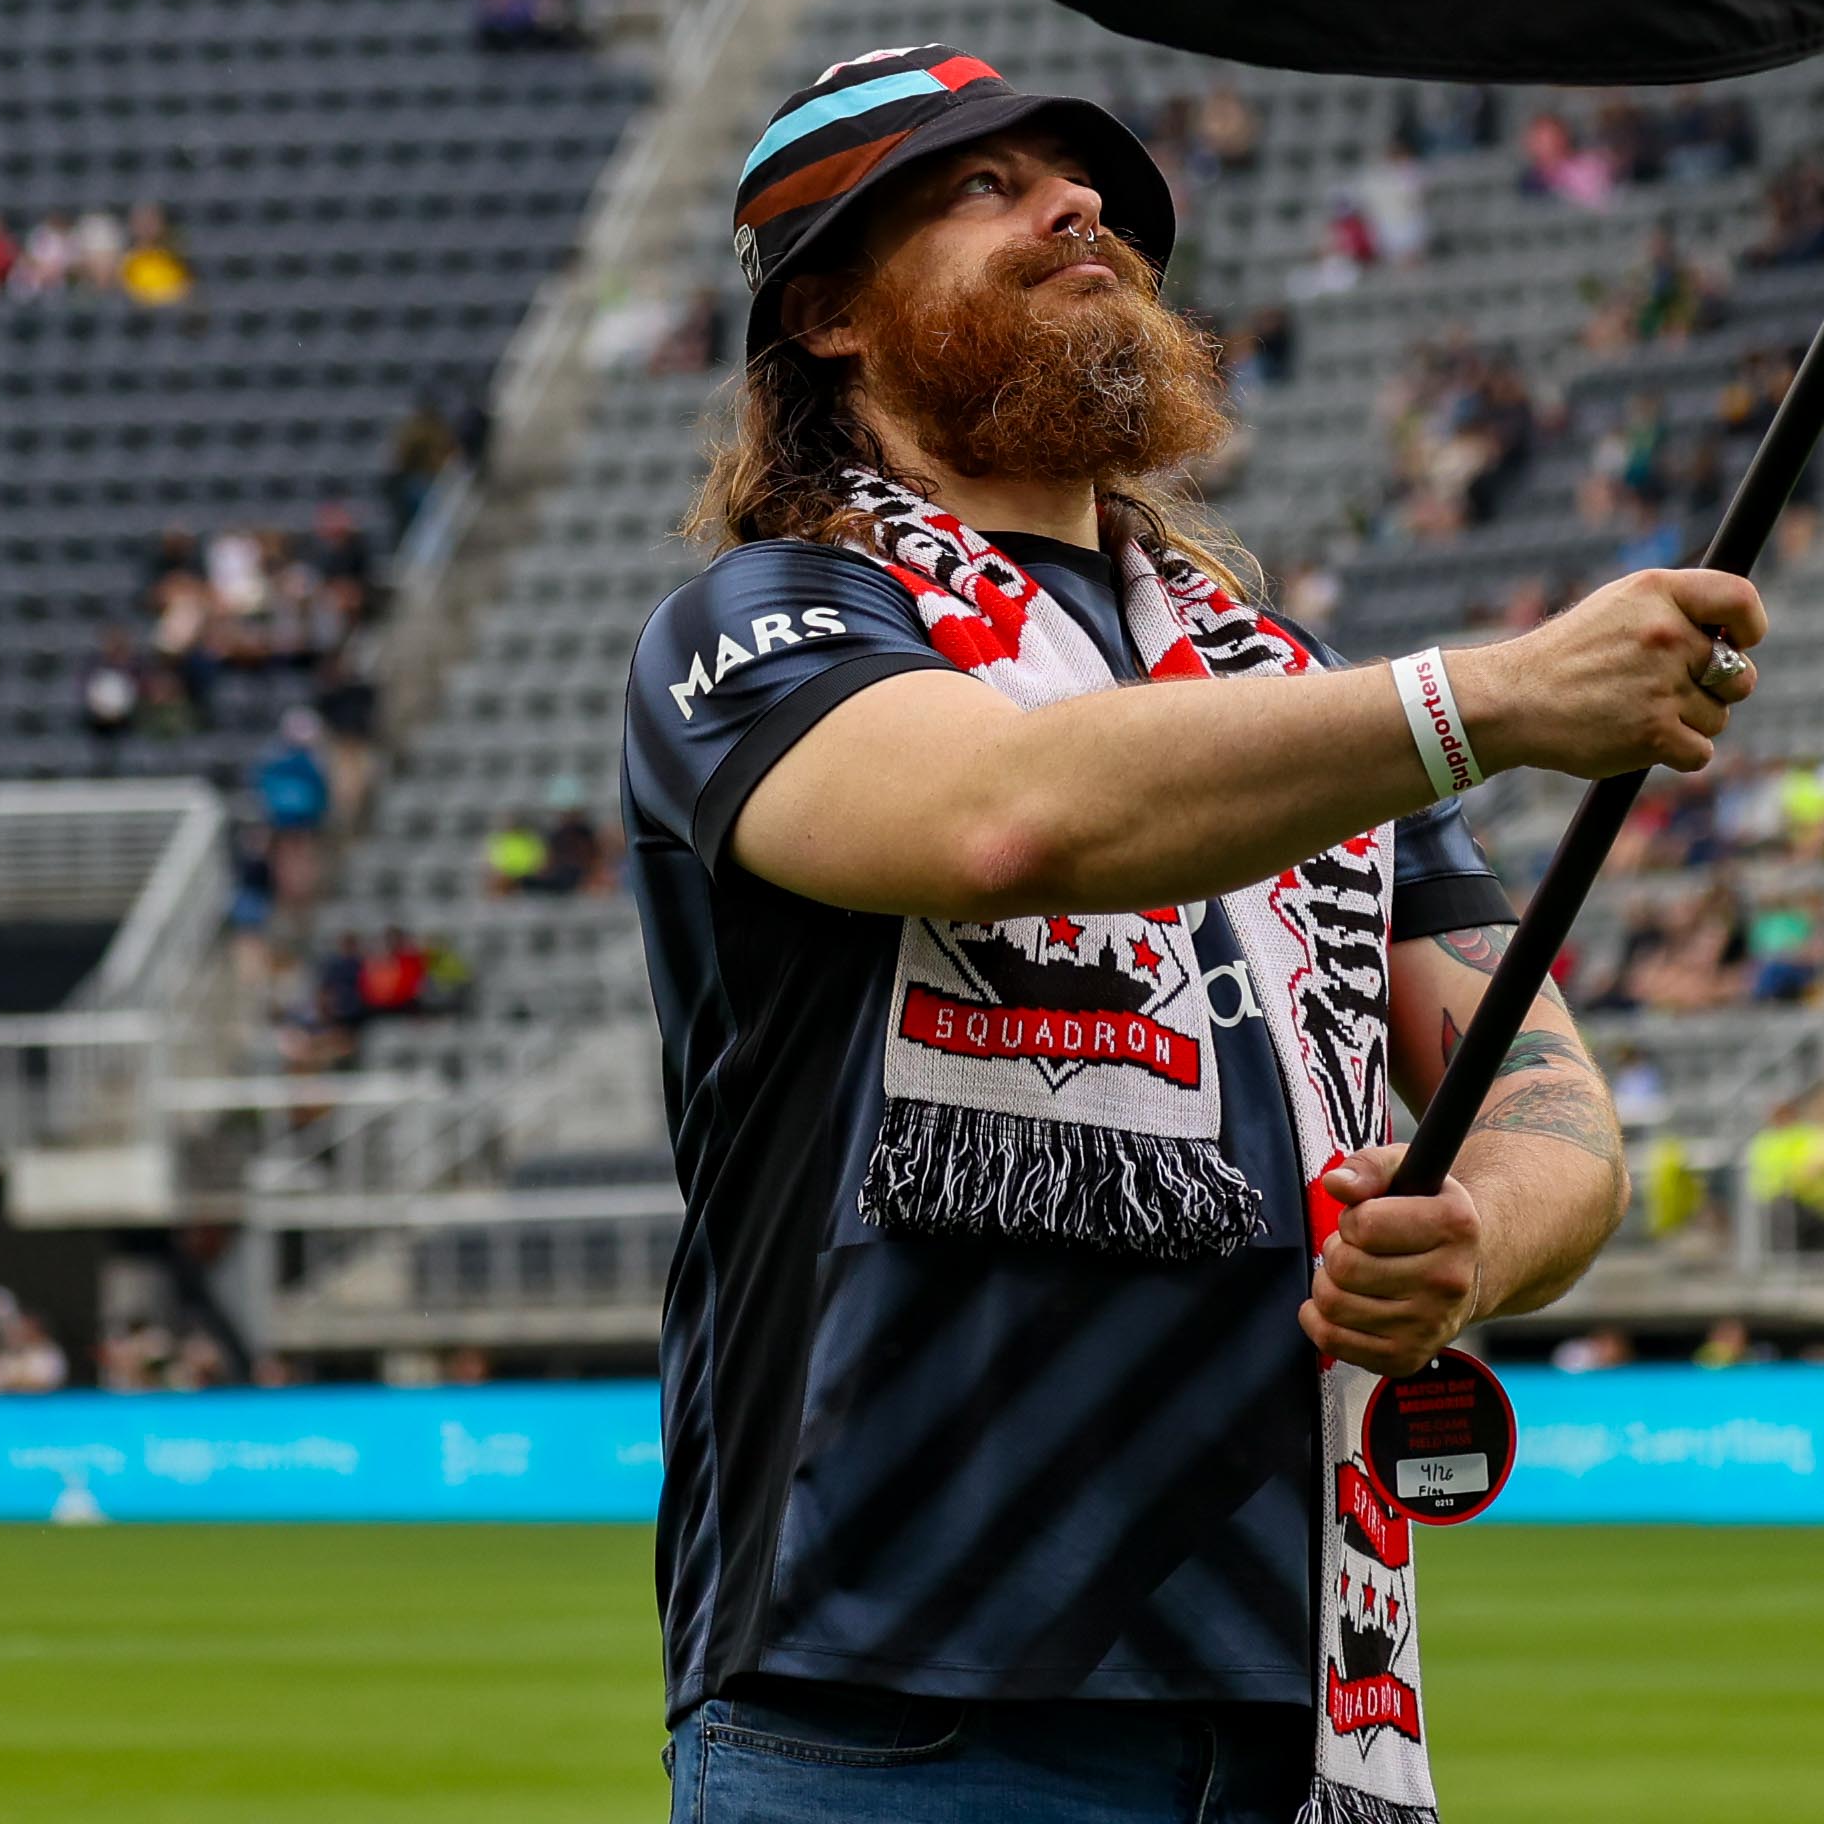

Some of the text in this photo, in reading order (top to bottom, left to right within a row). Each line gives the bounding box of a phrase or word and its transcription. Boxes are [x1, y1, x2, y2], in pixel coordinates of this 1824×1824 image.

[668, 606, 847, 721] MARS
[1416, 661, 1473, 791] Supporters
[935, 1007, 1171, 1065] SQUADRON
[1420, 1463, 1454, 1482] 4/26
[1354, 1480, 1386, 1554] SPIRIT
